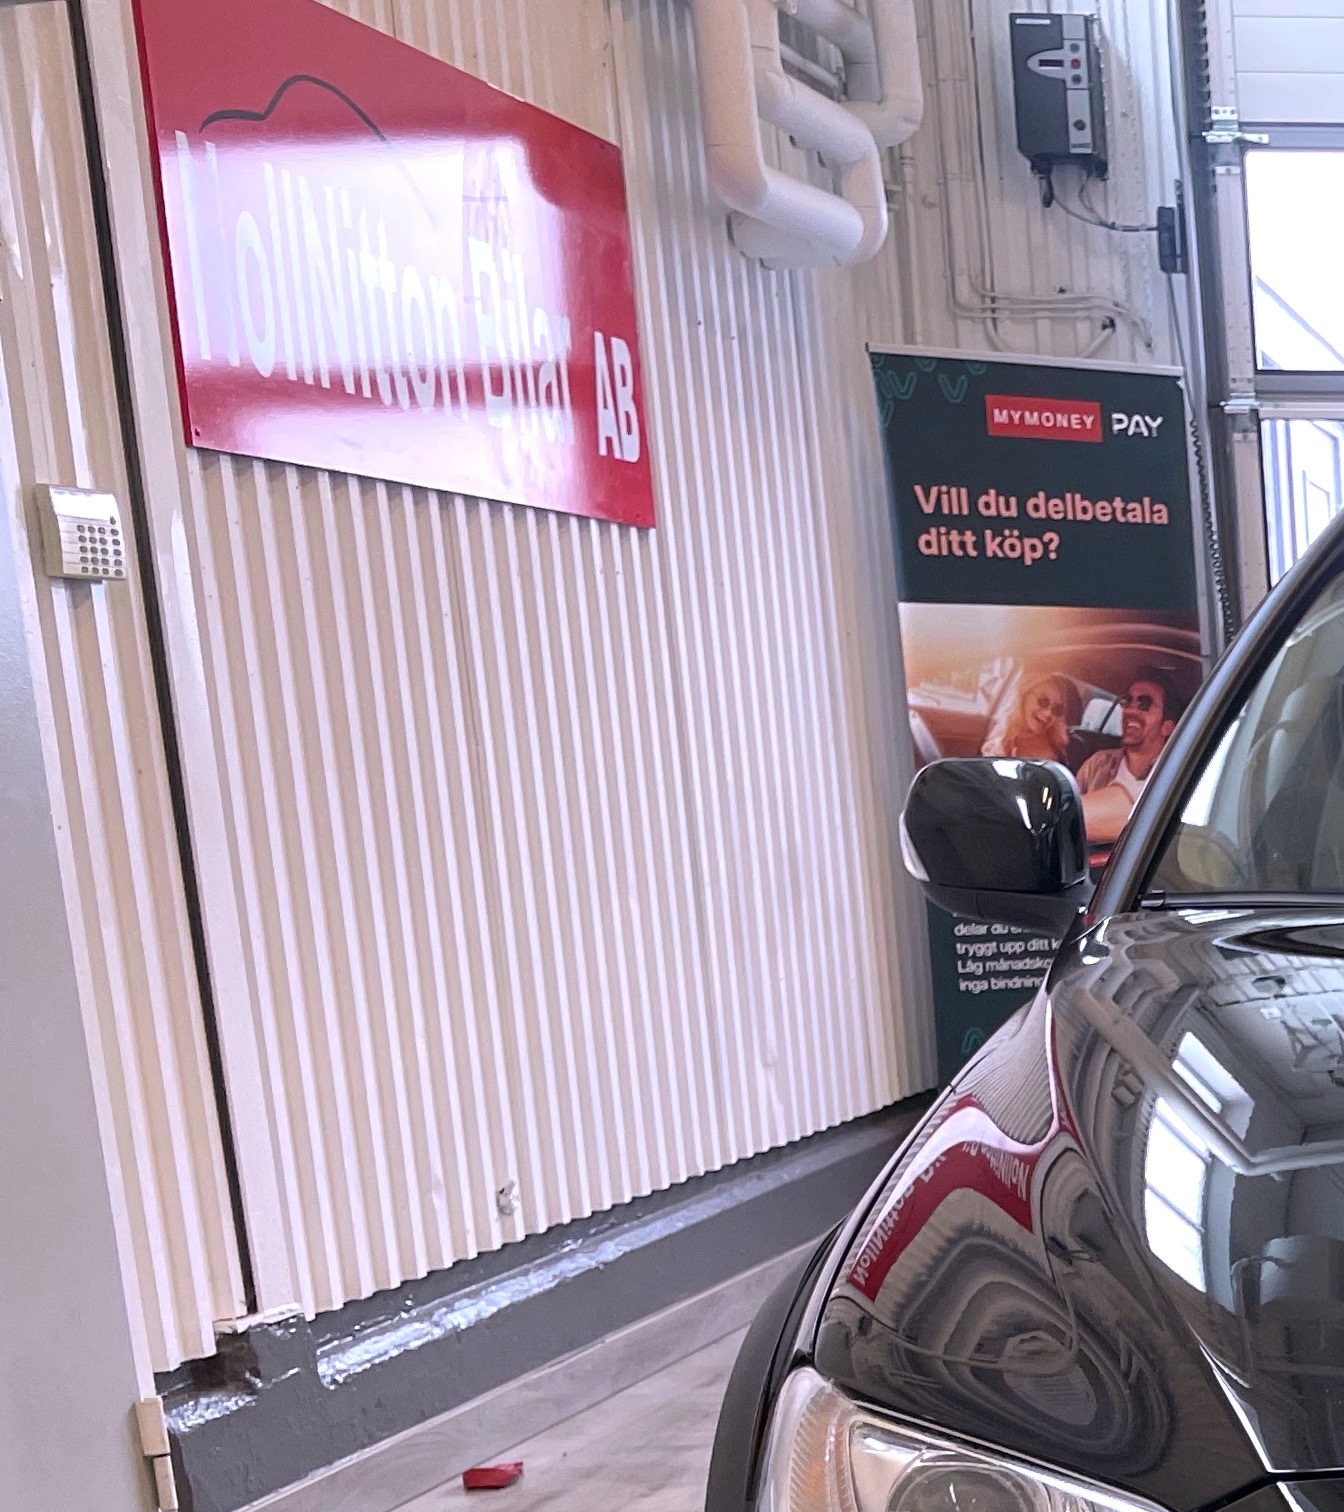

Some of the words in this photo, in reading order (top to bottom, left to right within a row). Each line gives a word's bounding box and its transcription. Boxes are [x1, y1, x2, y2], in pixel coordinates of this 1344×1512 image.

[594, 331, 640, 463] AB
[992, 408, 1095, 430] MYMONEY
[1111, 412, 1163, 437] PAY
[913, 484, 970, 516] Vill
[978, 488, 1018, 518] du
[1025, 491, 1169, 524] delbetala
[917, 526, 977, 557] ditt
[984, 528, 1060, 566] köp?
[999, 941, 1025, 955] upp
[1027, 938, 1049, 951] ditt
[985, 956, 1054, 972] månadsko
[959, 979, 988, 994] inga
